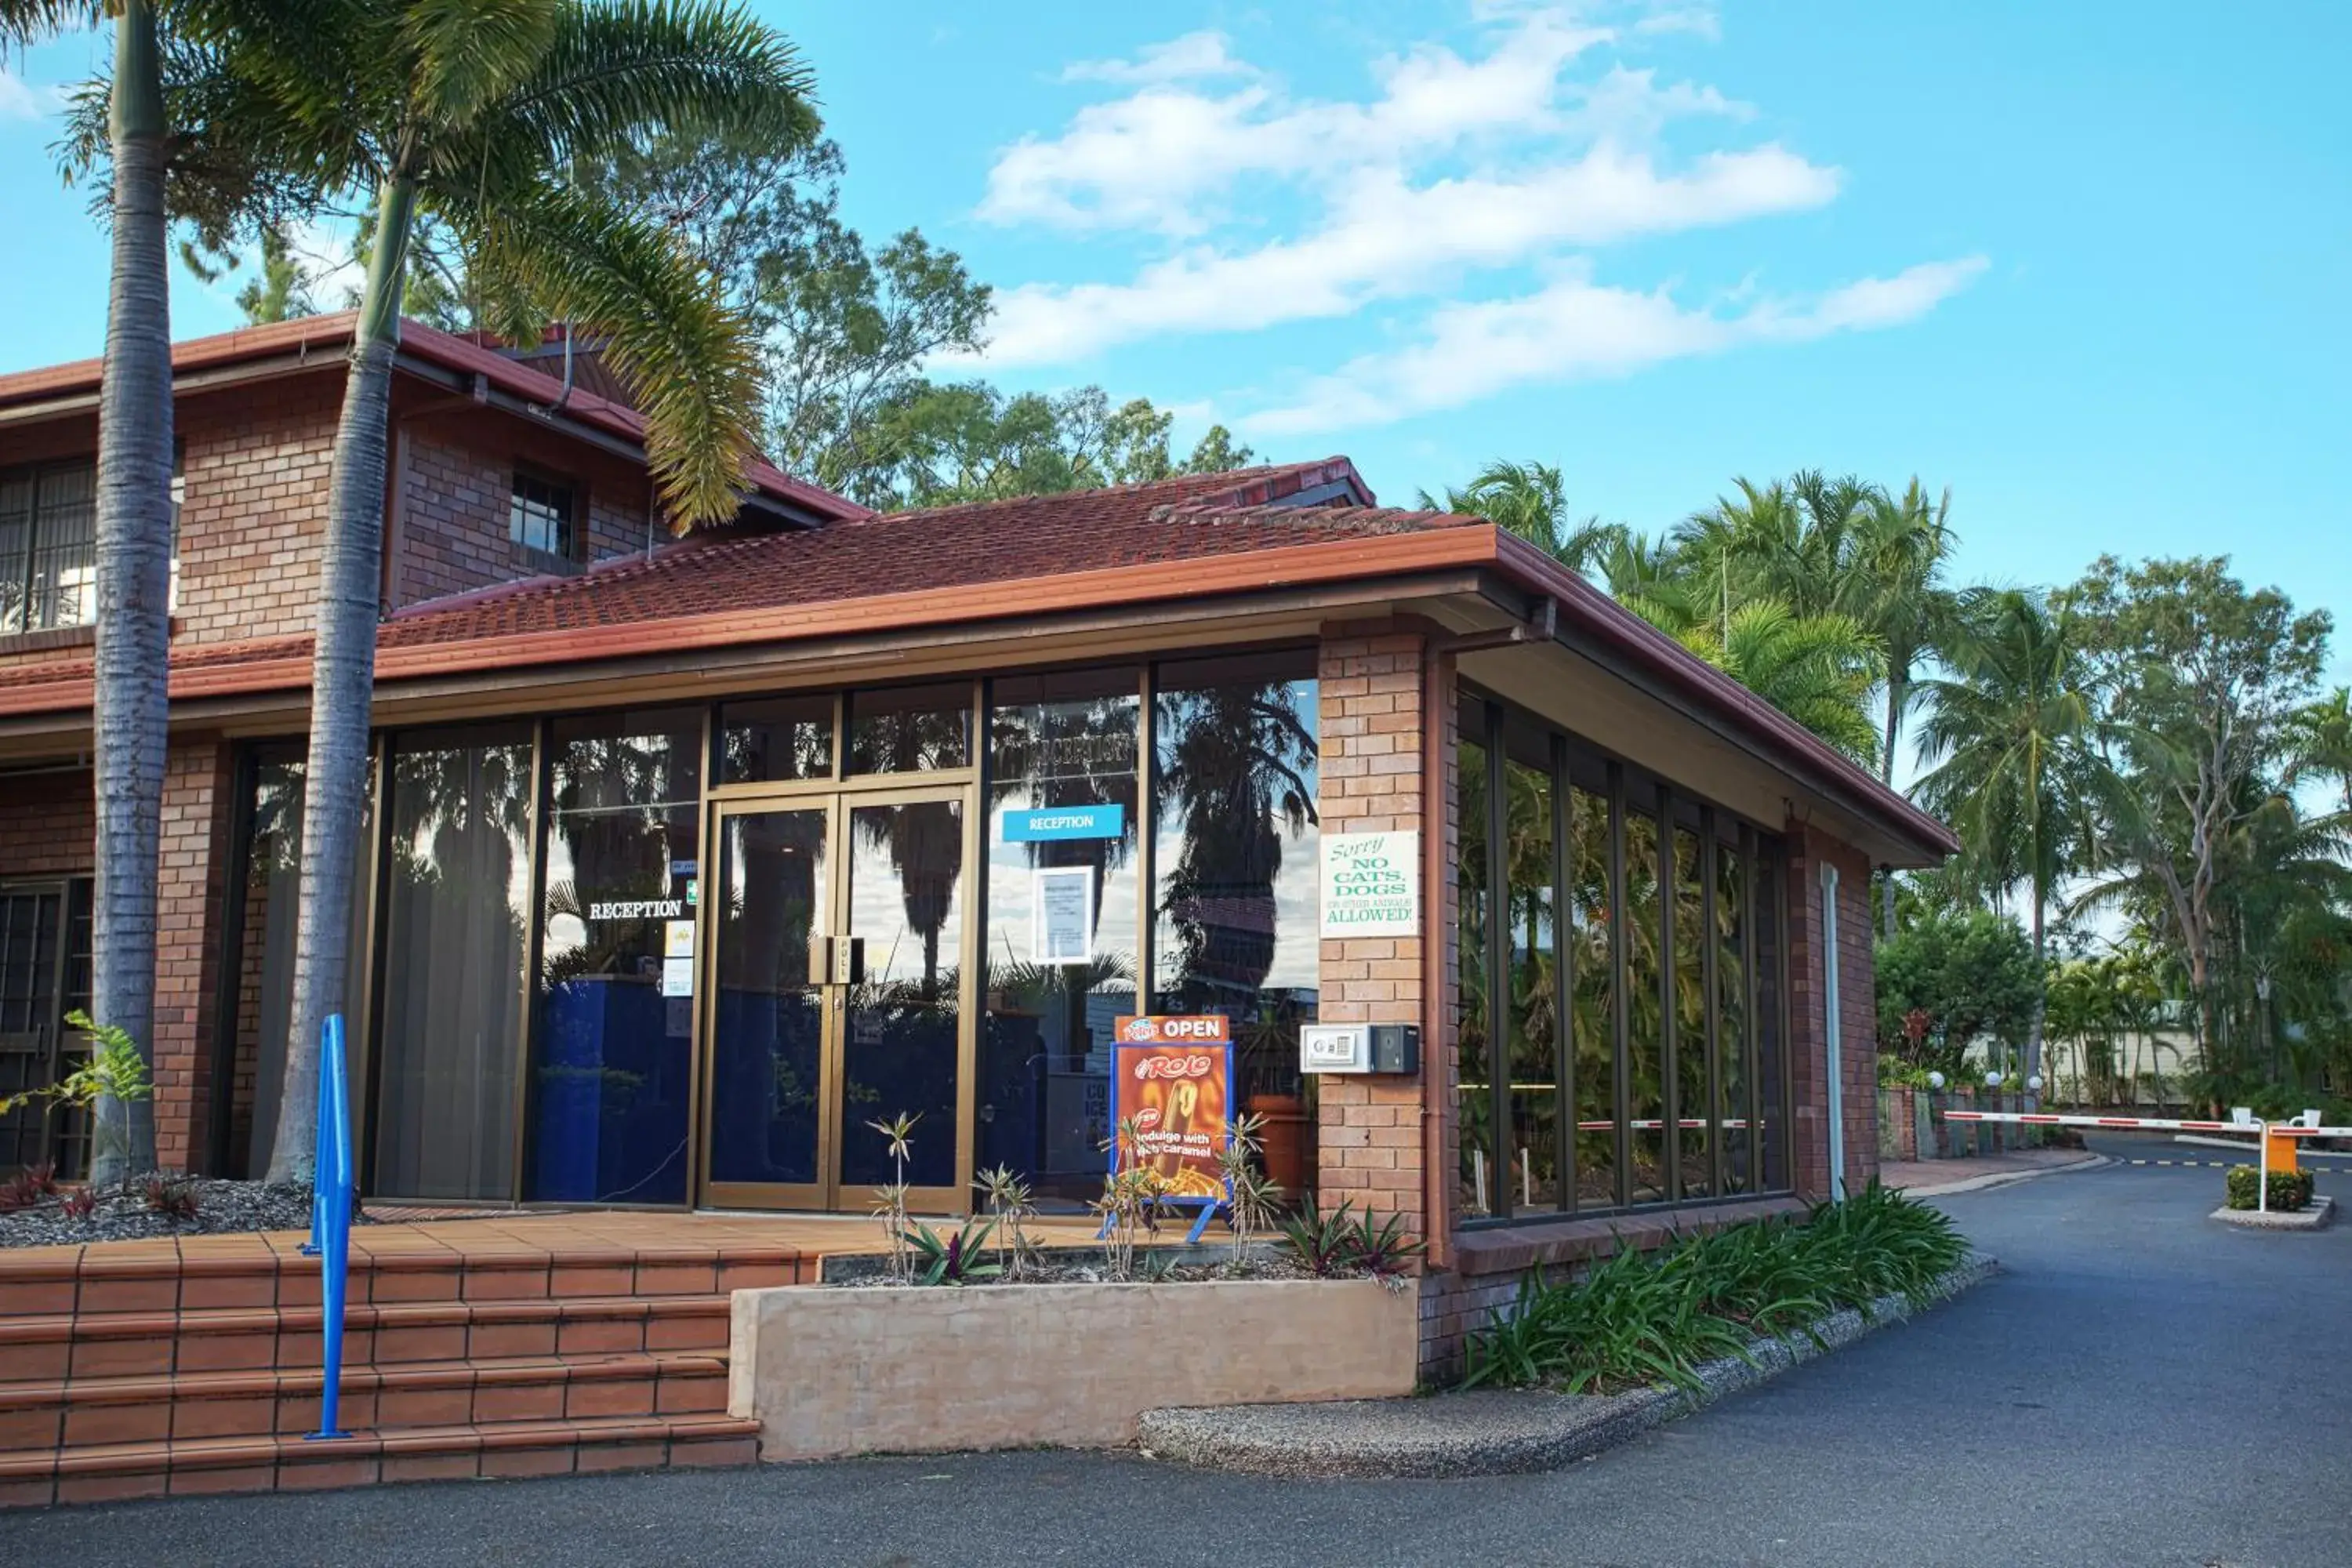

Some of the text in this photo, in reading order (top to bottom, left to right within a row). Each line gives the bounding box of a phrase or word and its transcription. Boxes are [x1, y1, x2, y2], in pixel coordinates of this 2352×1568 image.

[1029, 815, 1094, 830] RECEPTION
[1330, 837, 1385, 862] Sorry
[1352, 858, 1388, 869] NO
[1335, 884, 1406, 896] DOGS
[590, 900, 682, 920] RECEPTION
[1164, 1020, 1220, 1037] OPEN
[1183, 1134, 1210, 1145] with
[1163, 1144, 1211, 1158] caramel
